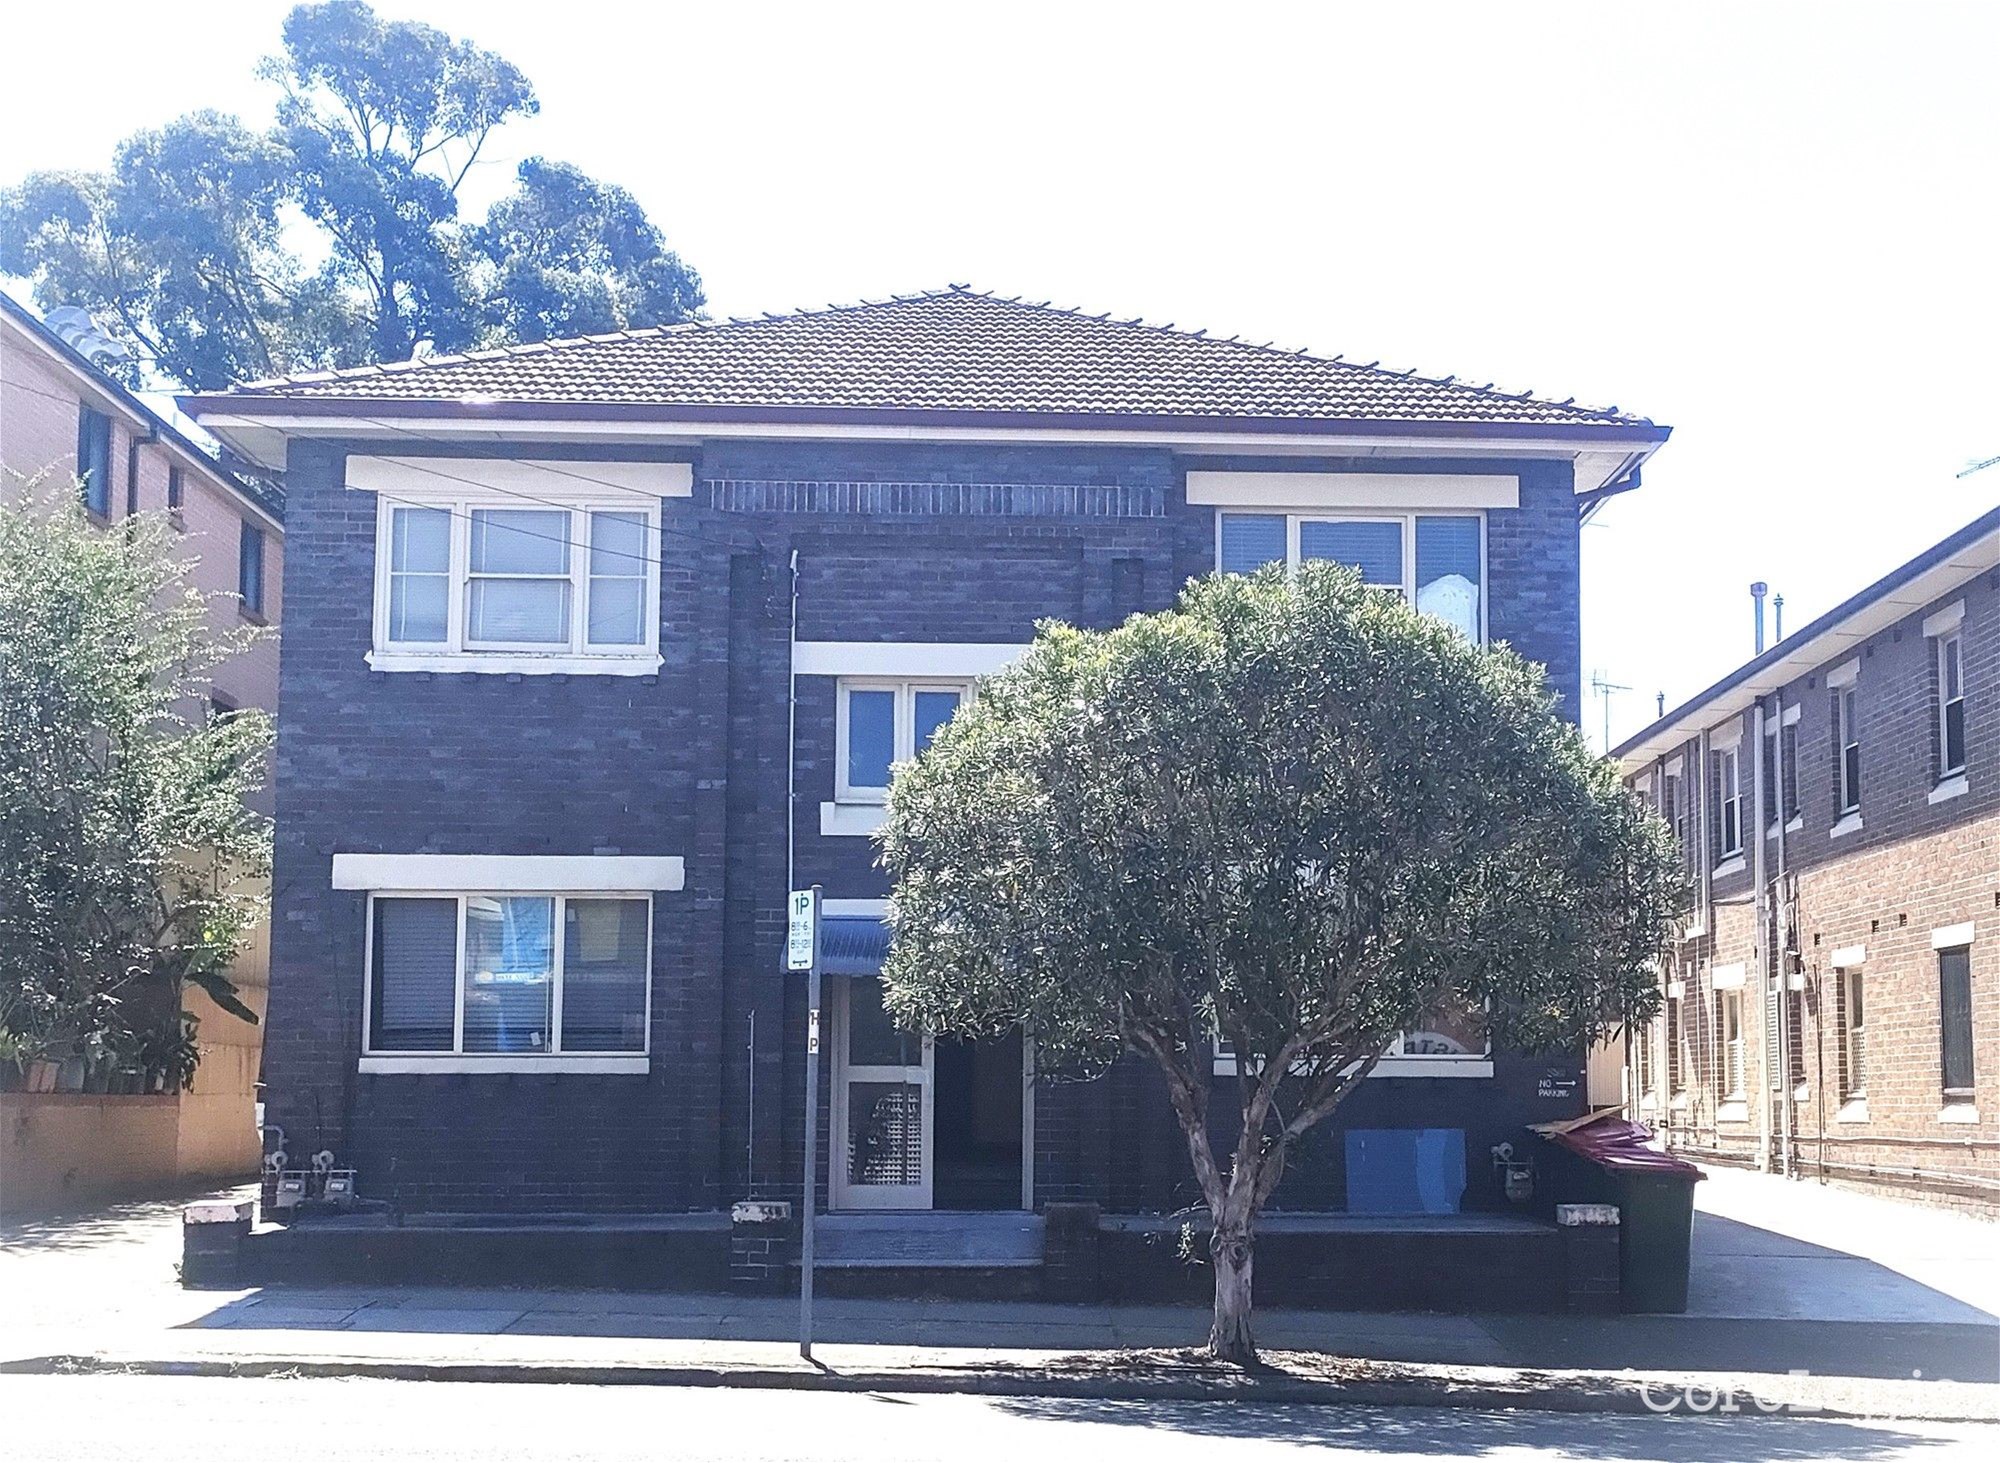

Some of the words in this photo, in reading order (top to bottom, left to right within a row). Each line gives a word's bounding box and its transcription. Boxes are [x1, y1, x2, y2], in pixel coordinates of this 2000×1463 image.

[795, 897, 809, 915] 1P
[1539, 1079, 1552, 1088] NO
[1538, 1088, 1570, 1098] PARKING
